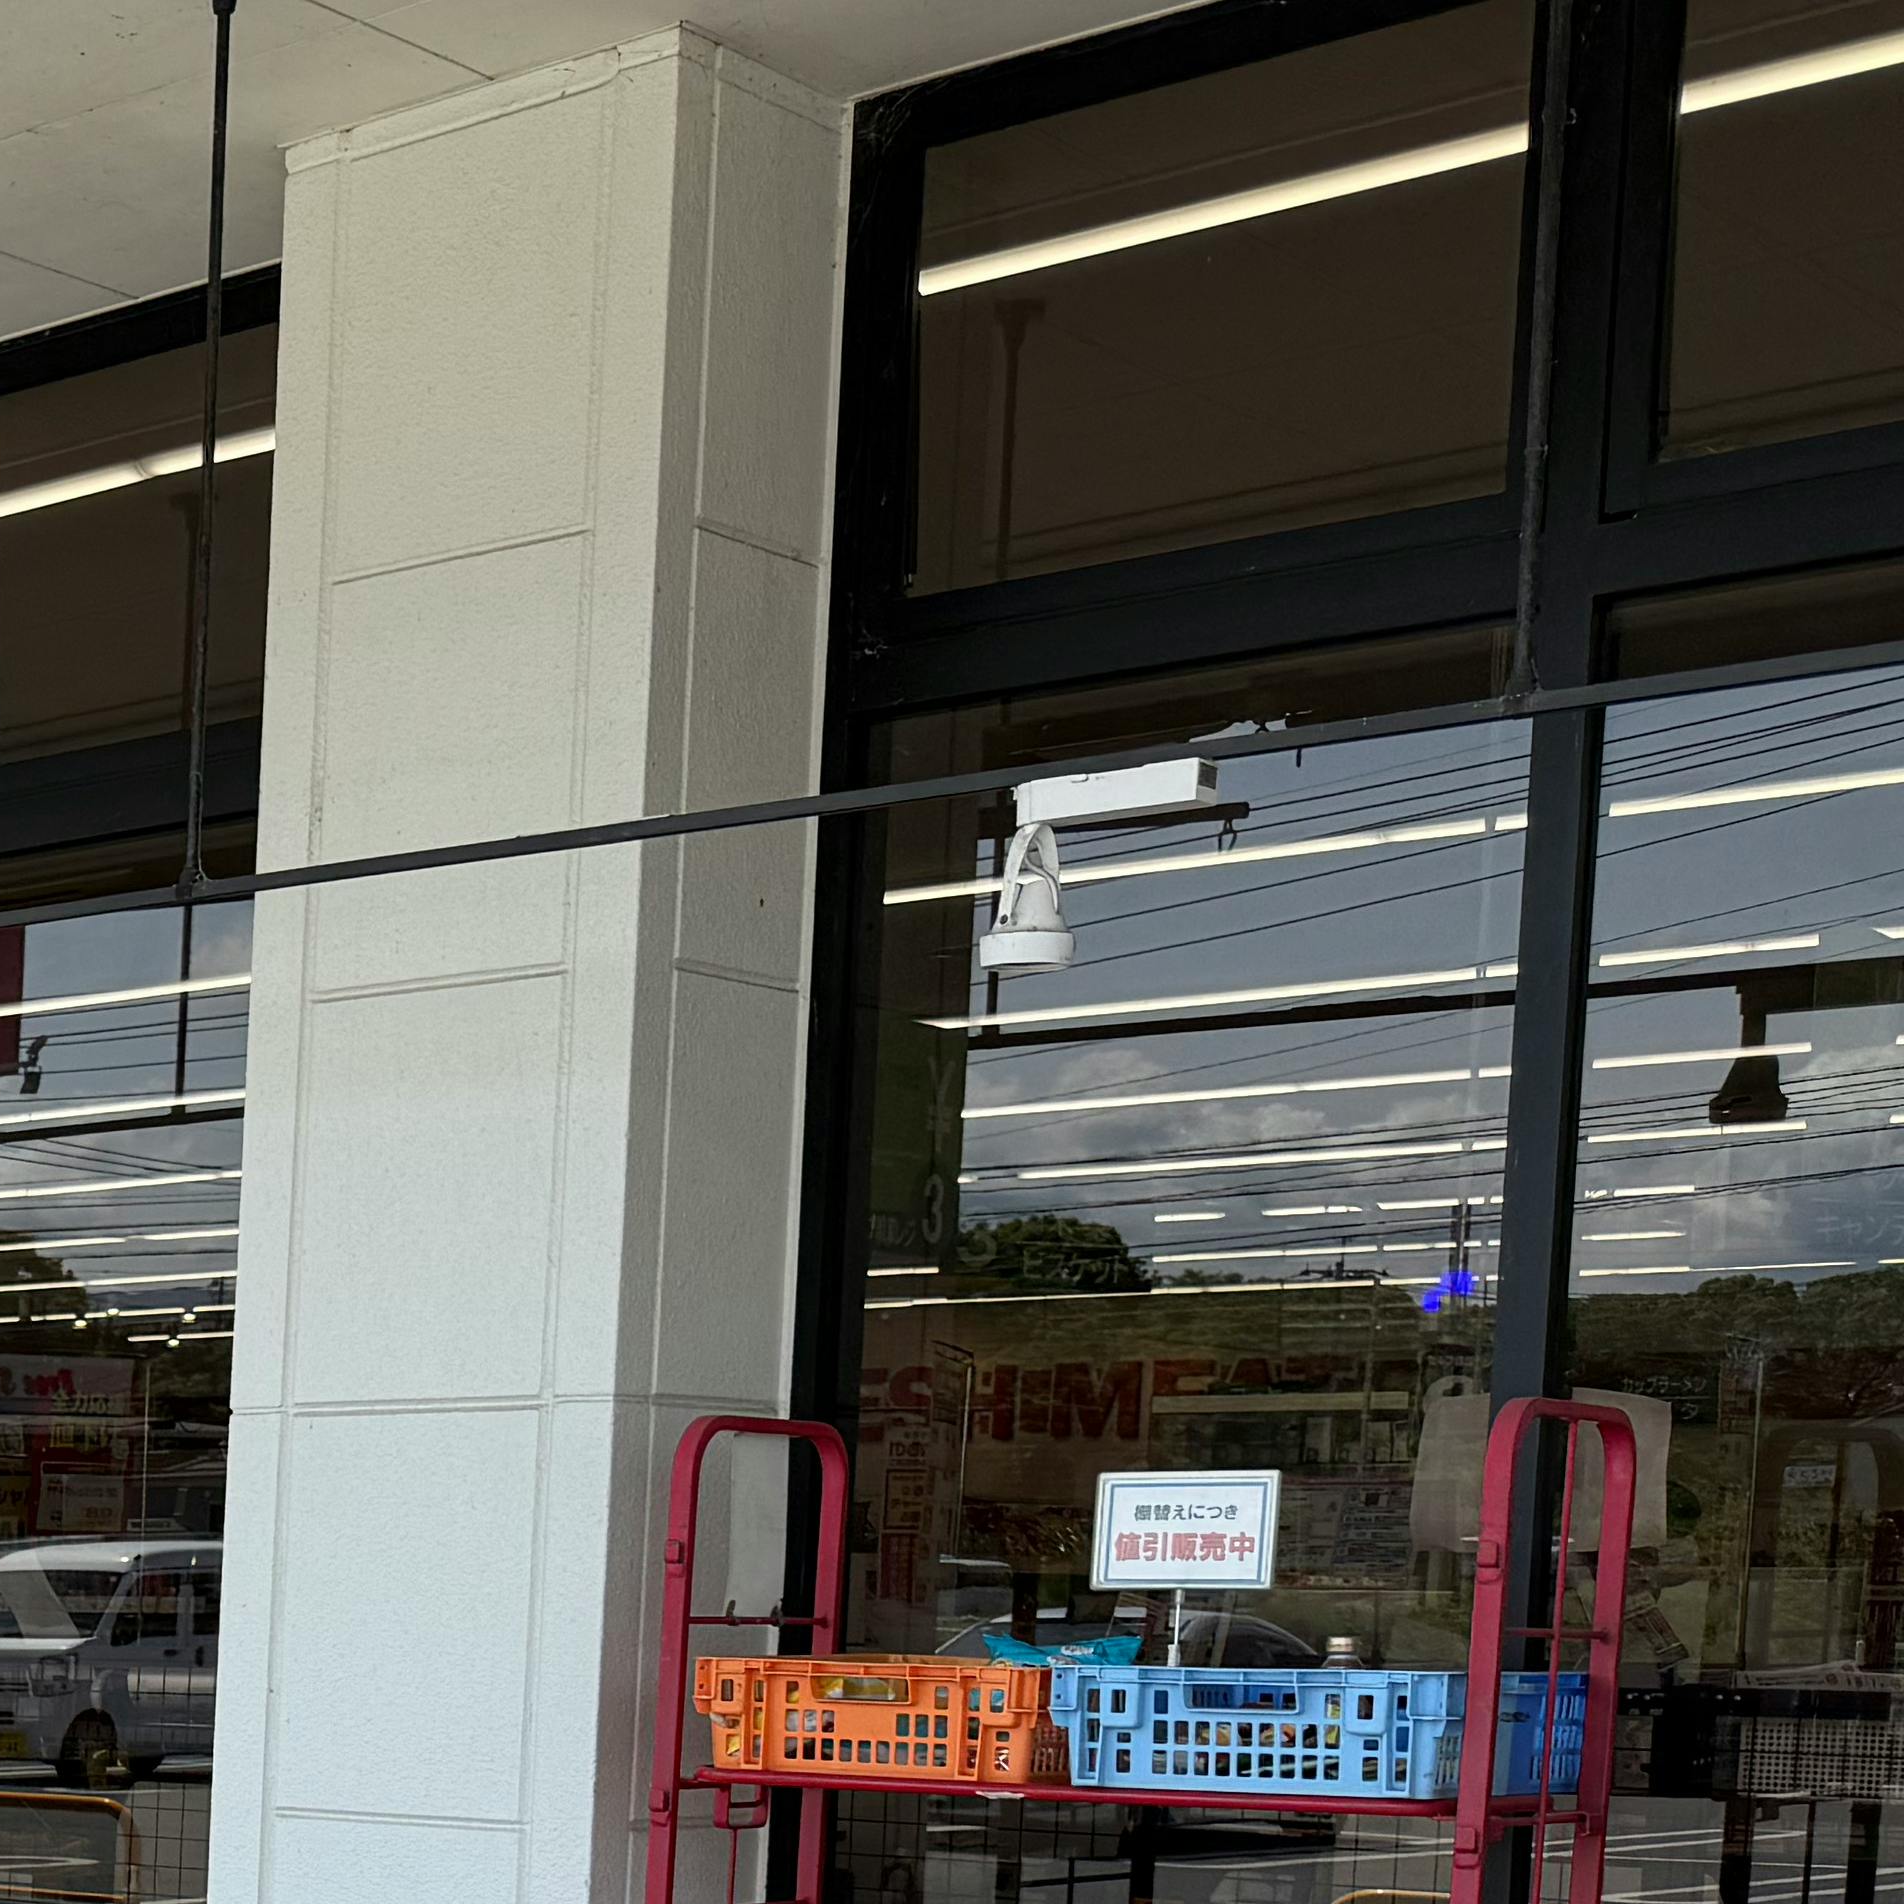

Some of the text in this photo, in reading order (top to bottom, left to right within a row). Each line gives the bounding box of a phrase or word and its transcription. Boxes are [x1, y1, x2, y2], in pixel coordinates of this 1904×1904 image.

[1134, 1503, 1239, 1521] 棚替えにつき
[1114, 1531, 1256, 1561] 値引販売中
